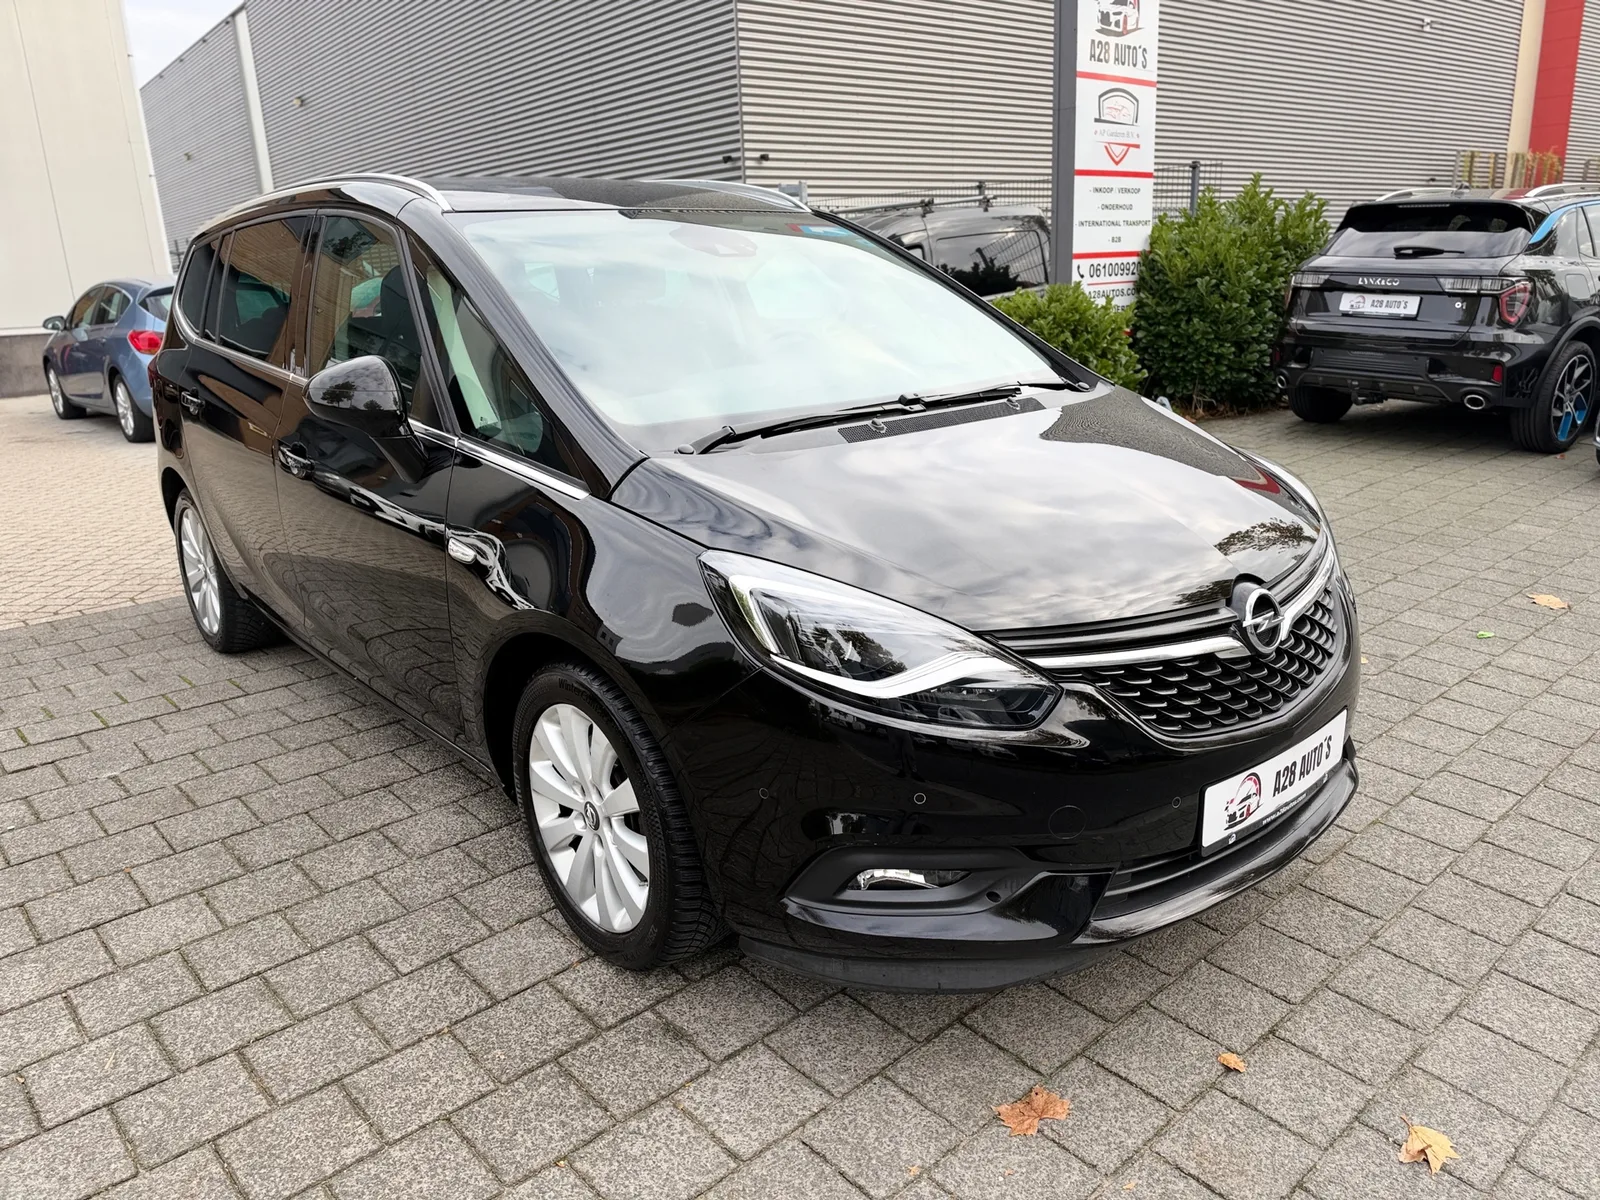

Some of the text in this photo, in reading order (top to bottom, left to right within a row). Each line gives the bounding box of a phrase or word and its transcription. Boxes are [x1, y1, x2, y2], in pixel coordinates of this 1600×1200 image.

[1089, 39, 1110, 64] A28
[1117, 187, 1141, 195] VERKOOP
[1100, 203, 1133, 211] ONDERHOUD
[1122, 219, 1151, 227] TRANSPORT
[1370, 299, 1383, 308] A28
[1273, 760, 1297, 797] A28
